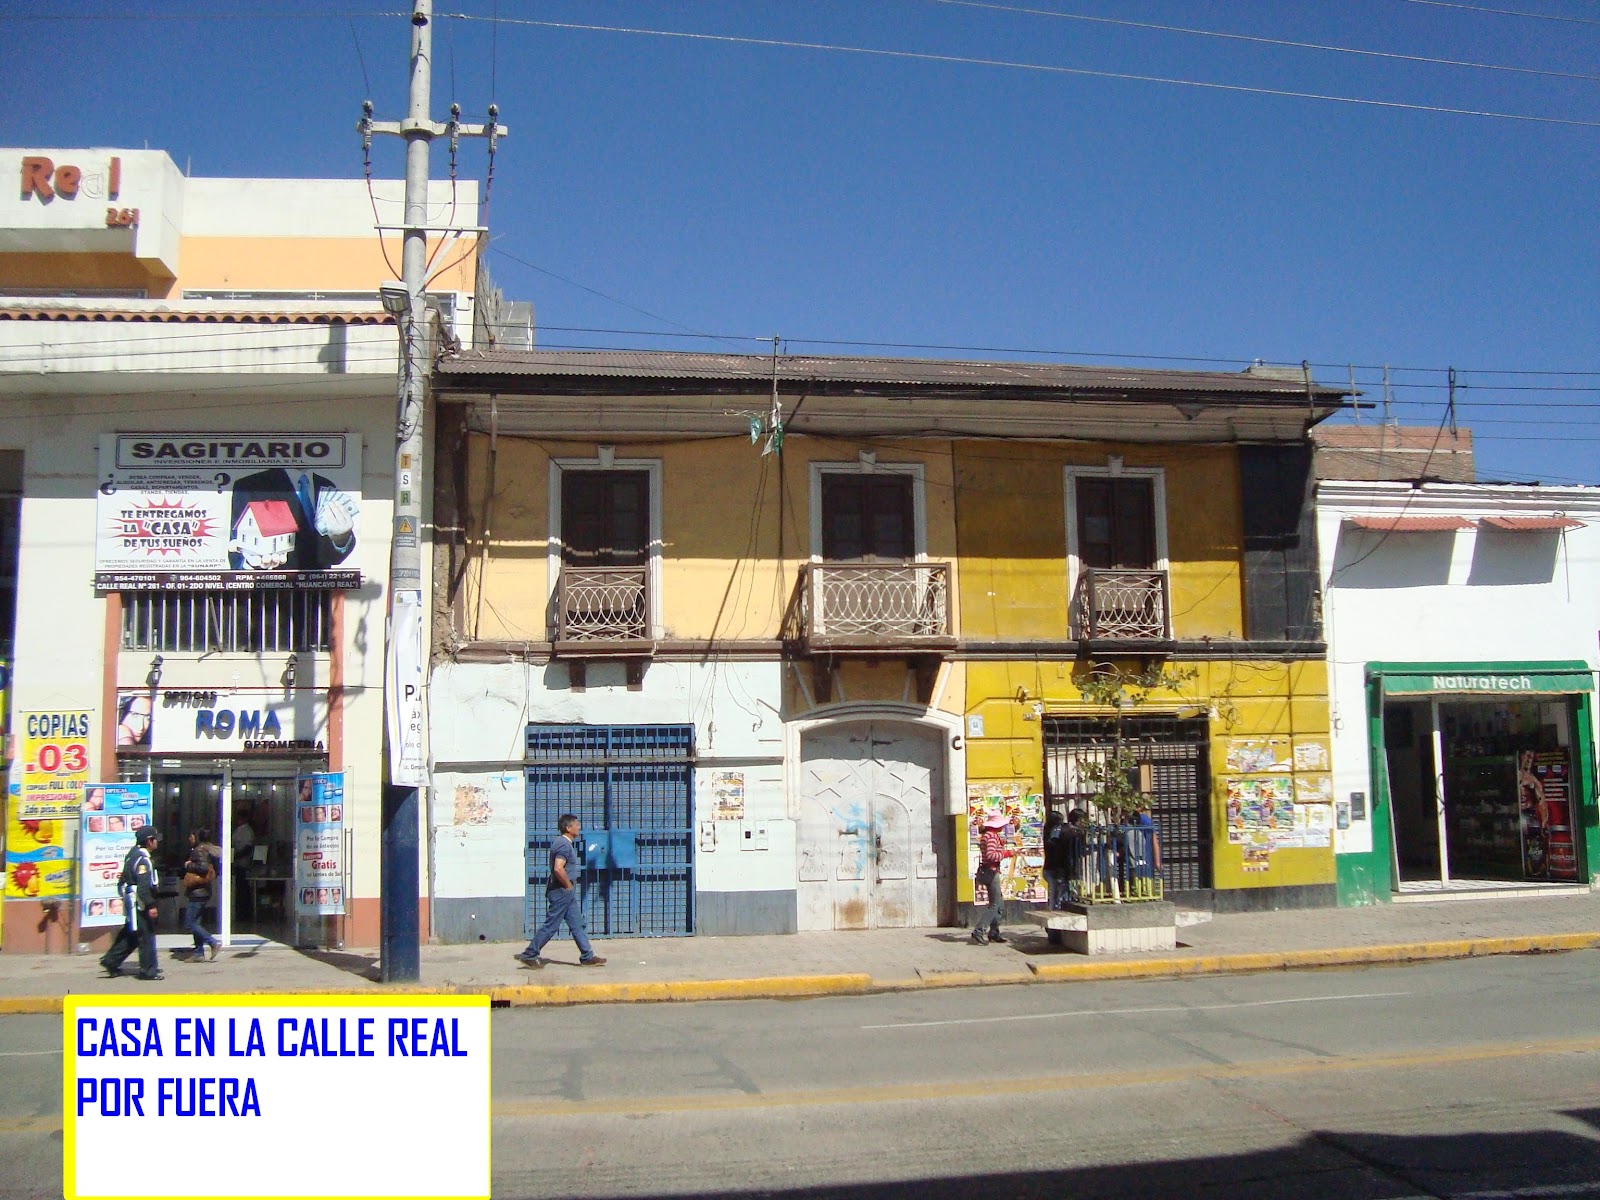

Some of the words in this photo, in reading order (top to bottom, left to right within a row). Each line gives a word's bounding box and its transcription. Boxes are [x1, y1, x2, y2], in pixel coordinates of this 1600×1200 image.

[105, 208, 140, 228] 261
[131, 442, 330, 458] SAGITARIO
[120, 510, 134, 519] TE
[136, 509, 207, 519] ENTREGAMOS
[124, 524, 137, 533] LA
[144, 521, 198, 535] "CASA"
[124, 539, 137, 548] DE
[141, 538, 160, 548] TUS
[163, 536, 203, 547] SUEÑOS
[1433, 675, 1531, 690] Naturatech
[163, 690, 217, 701] OPTICAS
[27, 713, 89, 738] COPIAS
[195, 709, 282, 733] ROMA
[243, 740, 324, 750] OPTOMETRIA
[25, 744, 88, 772] .03
[49, 781, 64, 790] FULL
[26, 793, 77, 801] IMPRESIONES
[311, 859, 337, 870] Gratis
